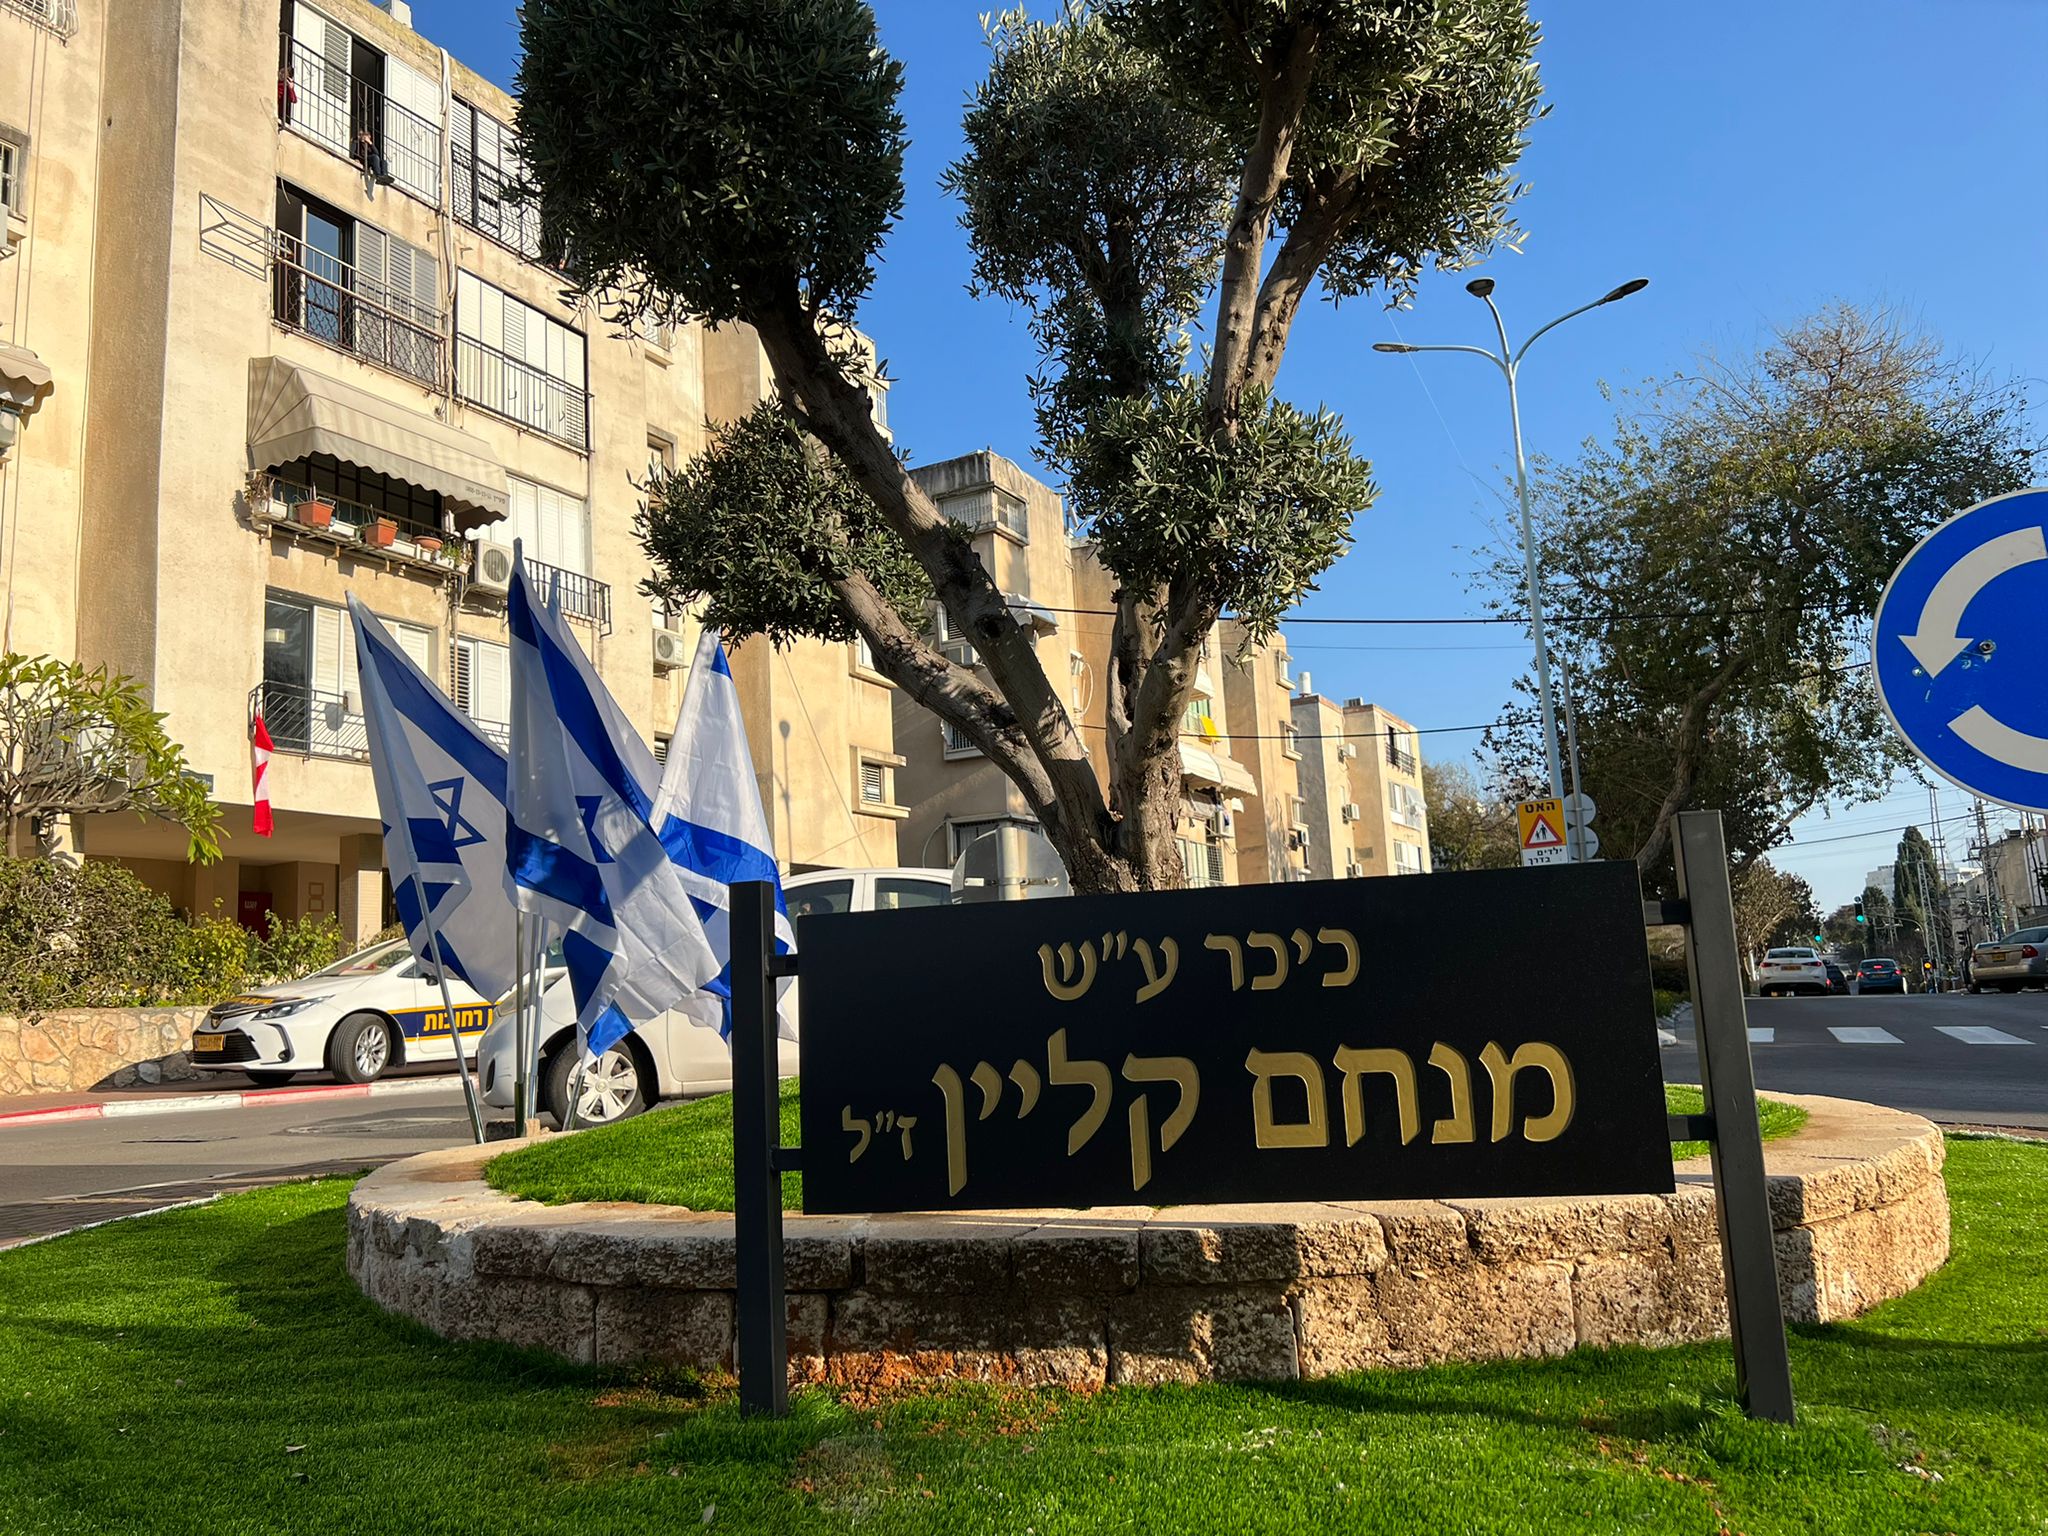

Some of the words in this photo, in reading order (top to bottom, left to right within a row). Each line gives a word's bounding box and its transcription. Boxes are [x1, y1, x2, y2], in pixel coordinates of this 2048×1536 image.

[1525, 801, 1555, 814] האט
[1528, 856, 1551, 866] בדרך
[1537, 847, 1563, 857] ילדים
[1204, 927, 1361, 991] כיכר
[932, 1027, 1201, 1197] קליין
[1245, 1040, 1578, 1149] מנחם
